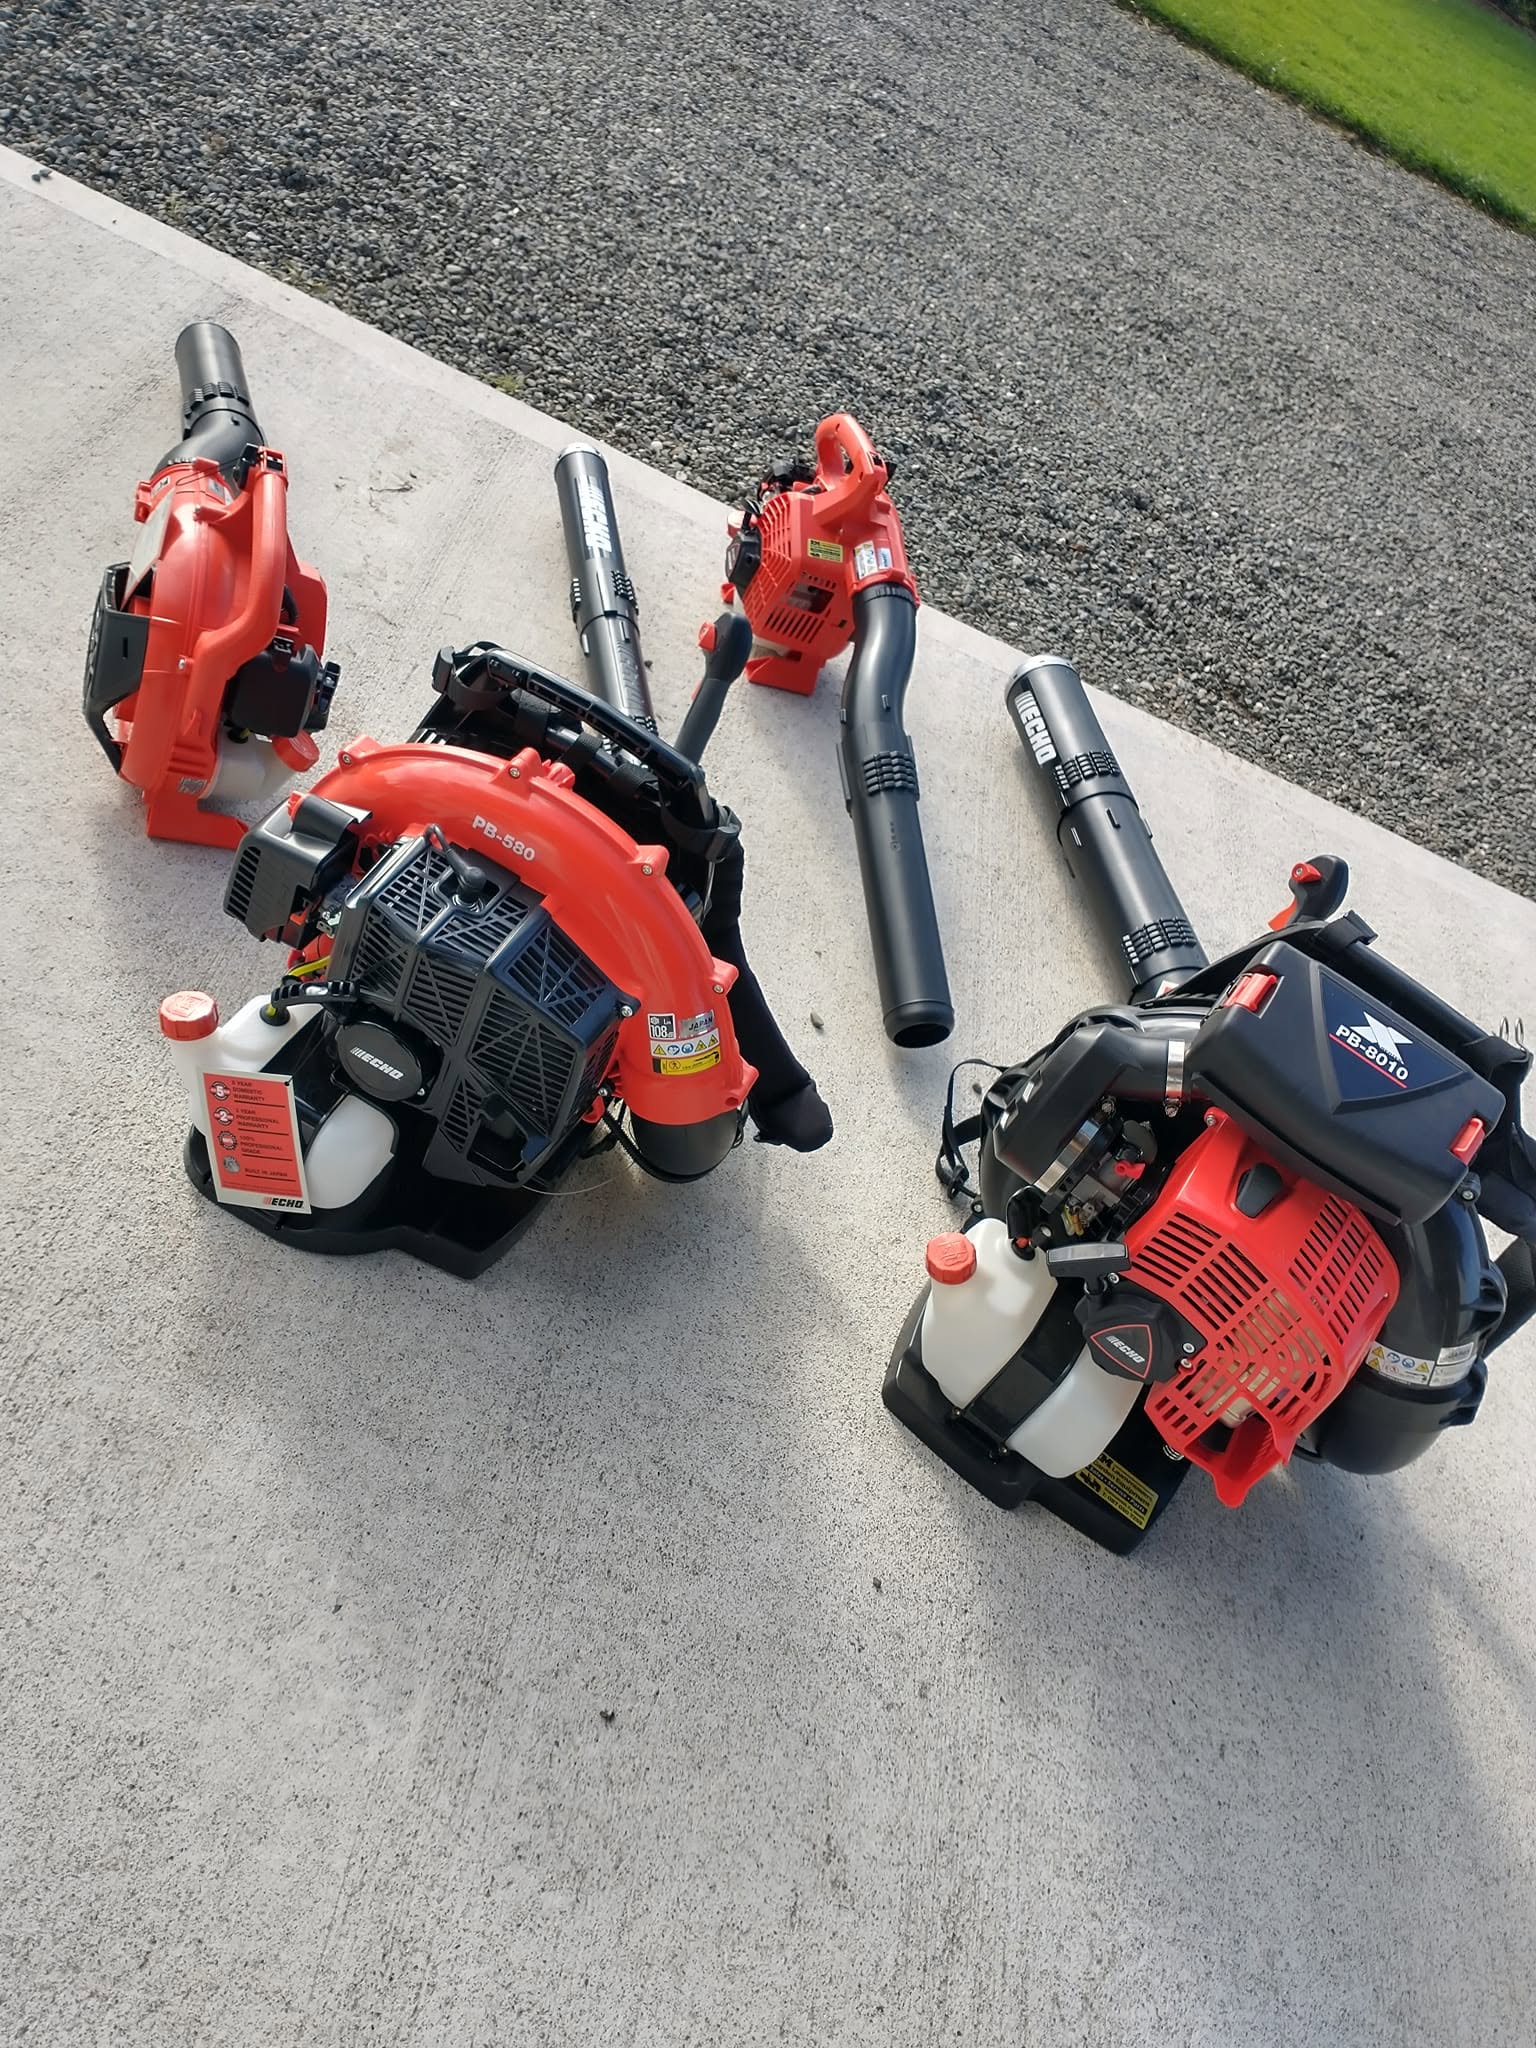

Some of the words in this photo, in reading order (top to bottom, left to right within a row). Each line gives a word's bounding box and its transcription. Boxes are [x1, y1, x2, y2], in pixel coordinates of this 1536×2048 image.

[1020, 704, 1057, 766] ECHO
[472, 815, 536, 861] PB-580
[688, 1017, 713, 1031] JAPAN
[650, 1025, 668, 1038] 108
[1335, 1024, 1409, 1080] PB-8010
[361, 1053, 404, 1080] ECHO
[216, 1085, 225, 1097] 5
[233, 1087, 263, 1095] DOMESTIC
[233, 1094, 265, 1102] WARRANTY
[220, 1110, 228, 1122] 2
[236, 1115, 280, 1124] PROFESSIONAL
[237, 1121, 269, 1129] WARRANTY
[240, 1141, 283, 1151] PROFESSIONAL
[271, 1198, 304, 1209] ECHO
[1113, 1339, 1146, 1364] ECHO
[1106, 1480, 1129, 1500] Service
[1129, 1498, 1146, 1514] Parts
[1114, 1477, 1151, 1508] Equipment
